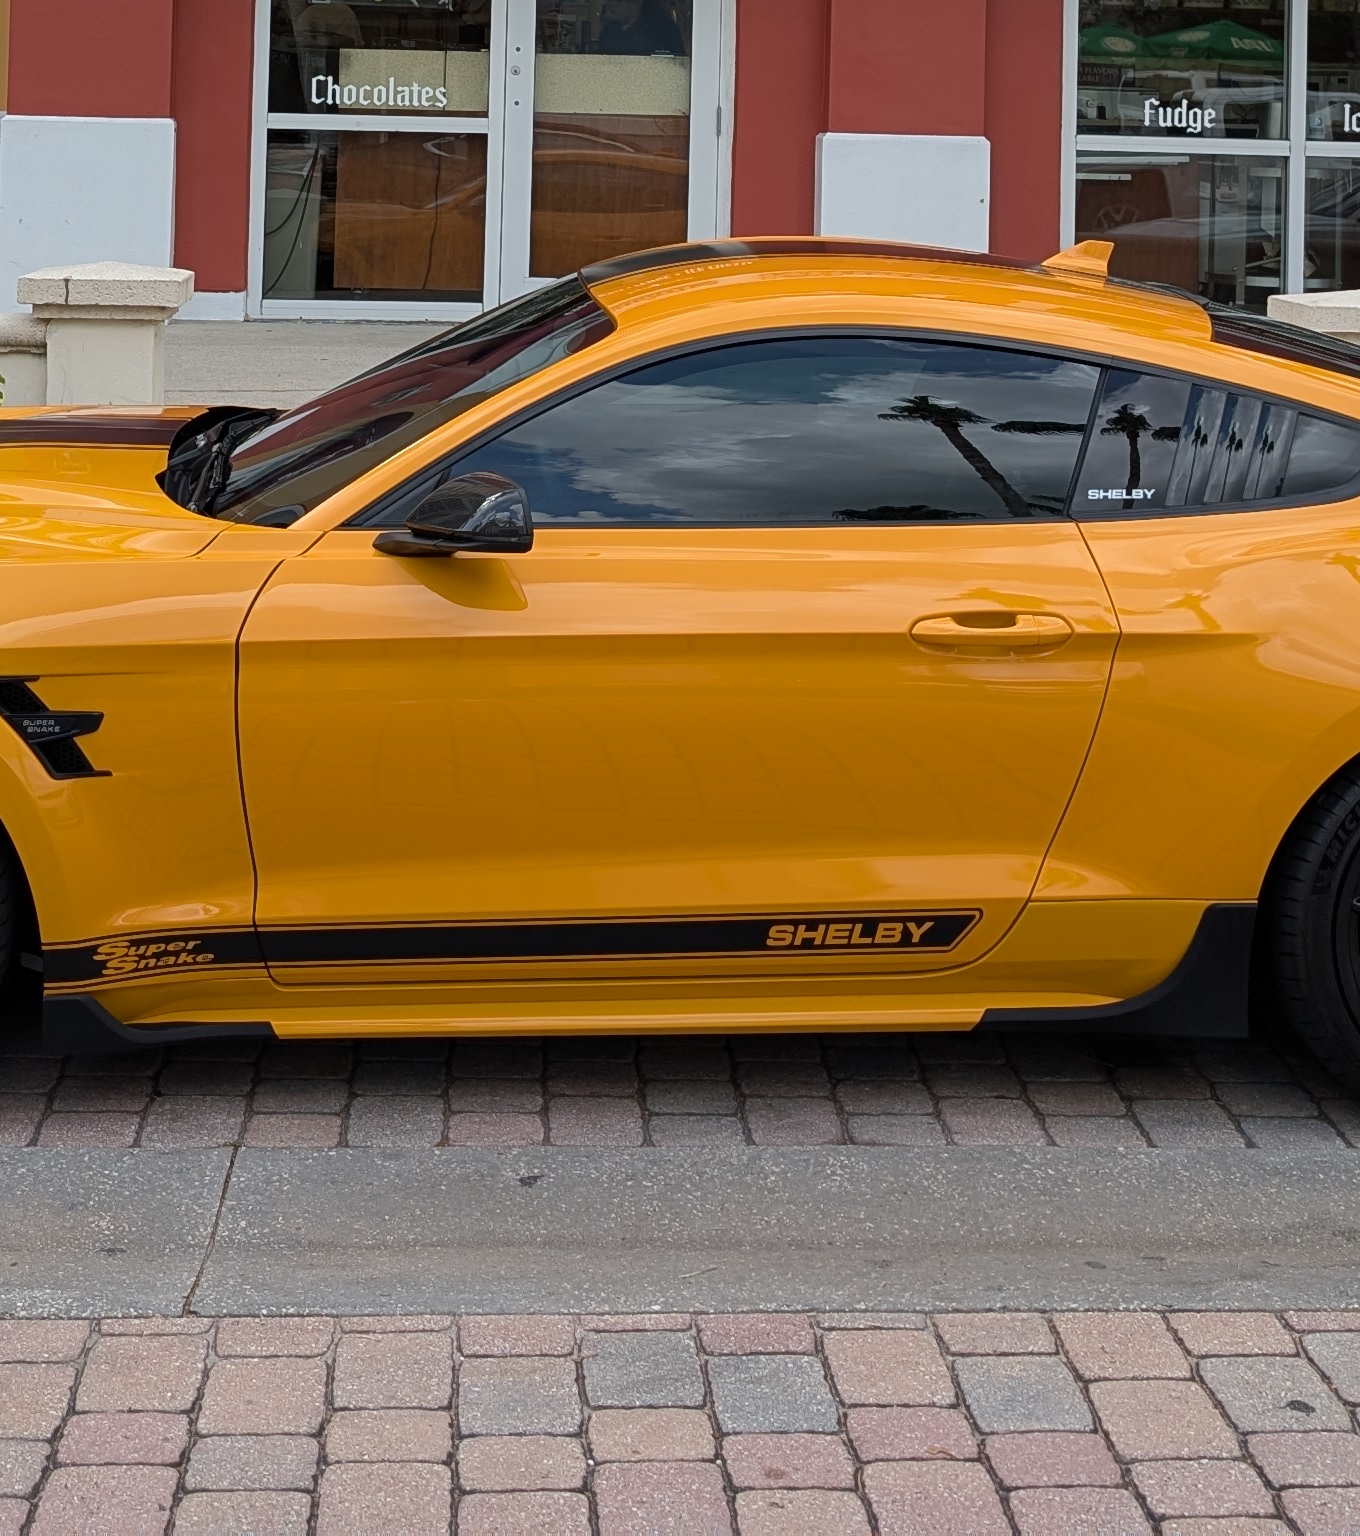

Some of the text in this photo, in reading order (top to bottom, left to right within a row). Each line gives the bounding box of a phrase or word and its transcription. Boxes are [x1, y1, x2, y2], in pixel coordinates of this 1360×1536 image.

[311, 75, 448, 108] Chocolates
[1143, 97, 1217, 134] Fudge
[1087, 487, 1156, 501] SHELBY
[27, 725, 61, 733] SNAKE
[766, 919, 935, 949] SHELBY
[92, 939, 202, 961] Super
[101, 952, 215, 975] Snake
